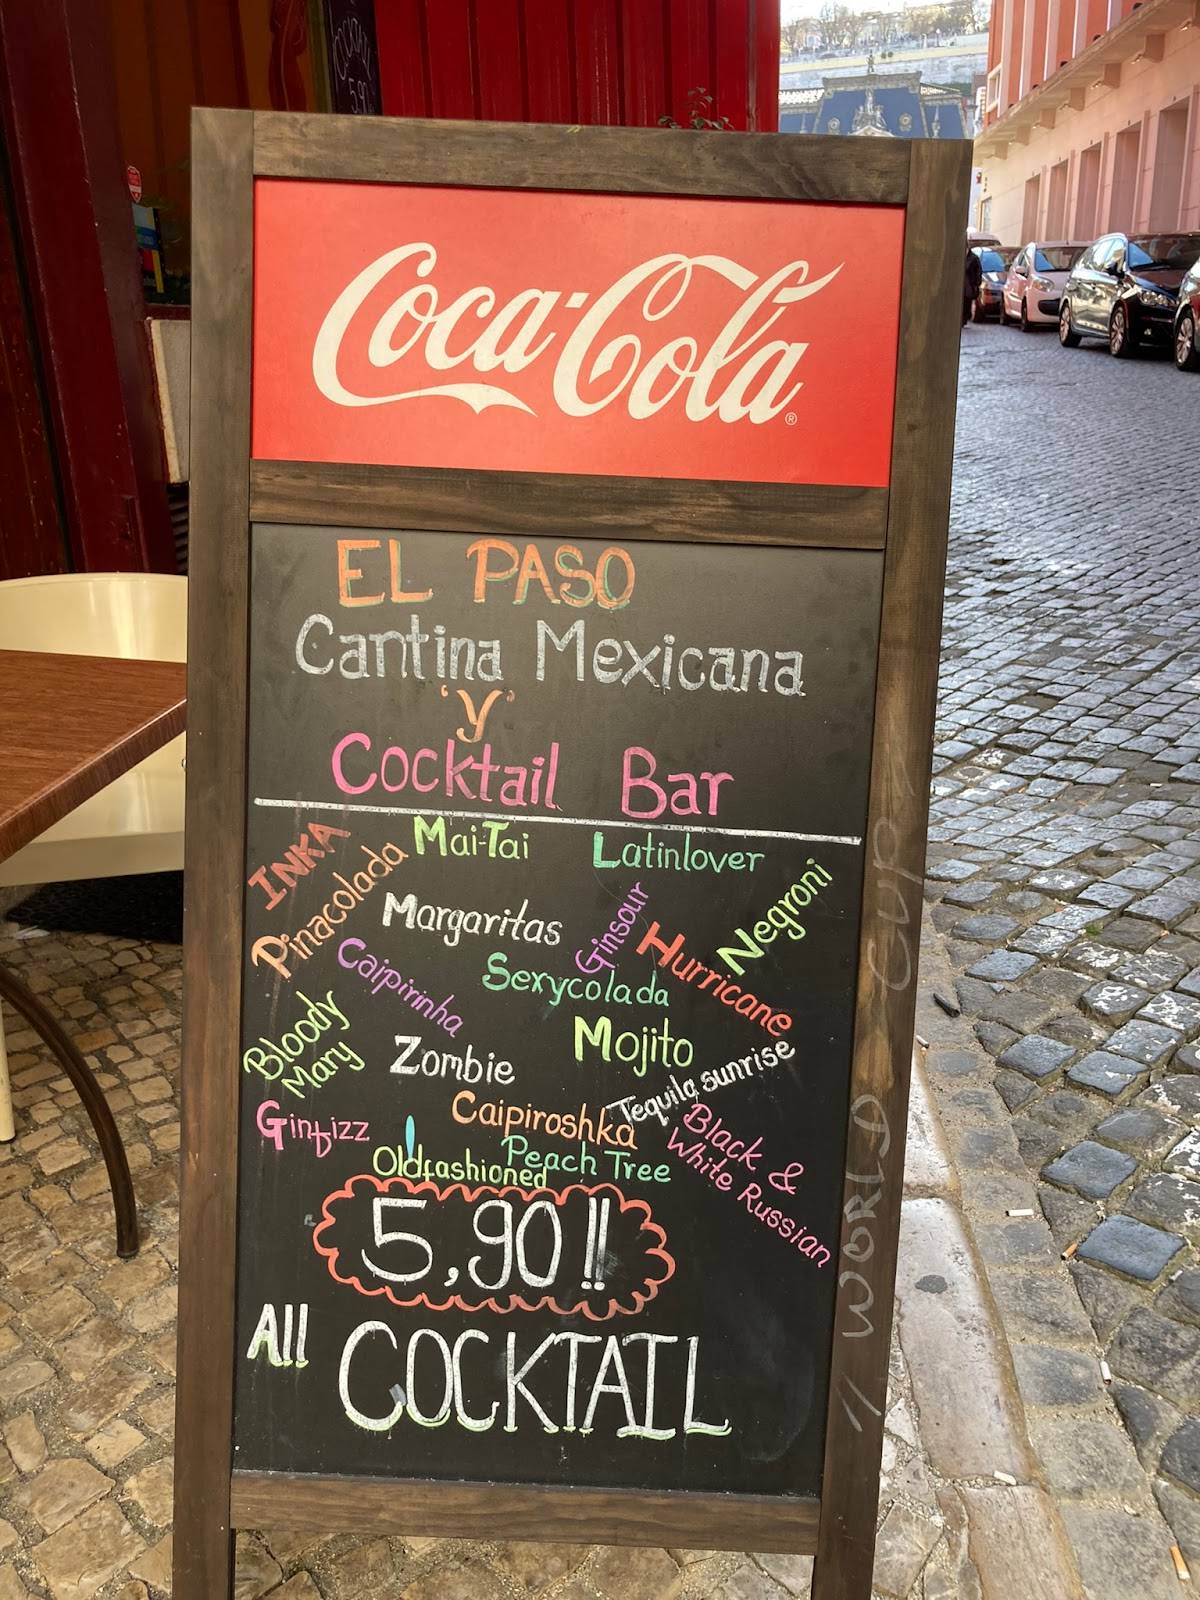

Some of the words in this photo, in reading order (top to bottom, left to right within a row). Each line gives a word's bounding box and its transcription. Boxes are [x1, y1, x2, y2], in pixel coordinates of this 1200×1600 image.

[312, 242, 845, 425] Coca-Cola
[337, 539, 433, 607] EL
[466, 538, 635, 609] PASO
[296, 614, 505, 681] Cantina
[536, 619, 806, 697] Mexicana
[332, 732, 560, 811] Cocktail
[621, 746, 735, 819] Bar
[248, 822, 351, 911] INKA
[413, 815, 529, 859] Mai-Tai
[593, 831, 765, 873] Latinlover
[251, 842, 408, 980] Pinacolada
[382, 891, 564, 946] Margaritas
[716, 858, 833, 976] Negroni
[336, 937, 464, 1038] Caipirinha
[636, 920, 793, 1037] Hurricane
[243, 990, 351, 1080] Bloody
[281, 1041, 366, 1098] Mary
[389, 1034, 516, 1085] Zombie
[574, 1015, 694, 1077] Mojito
[452, 1089, 638, 1150] Caipiroshka
[605, 1074, 700, 1127] Tequila
[701, 1040, 796, 1092] sunrise
[256, 1099, 370, 1158] Ginfizz
[501, 1135, 597, 1176] Peach
[604, 1150, 672, 1183] Tree
[683, 1103, 763, 1171] Black
[666, 1126, 733, 1191] White
[737, 1182, 833, 1268] Russian
[246, 1303, 309, 1368] All
[338, 1320, 732, 1441] COCKTAIL
